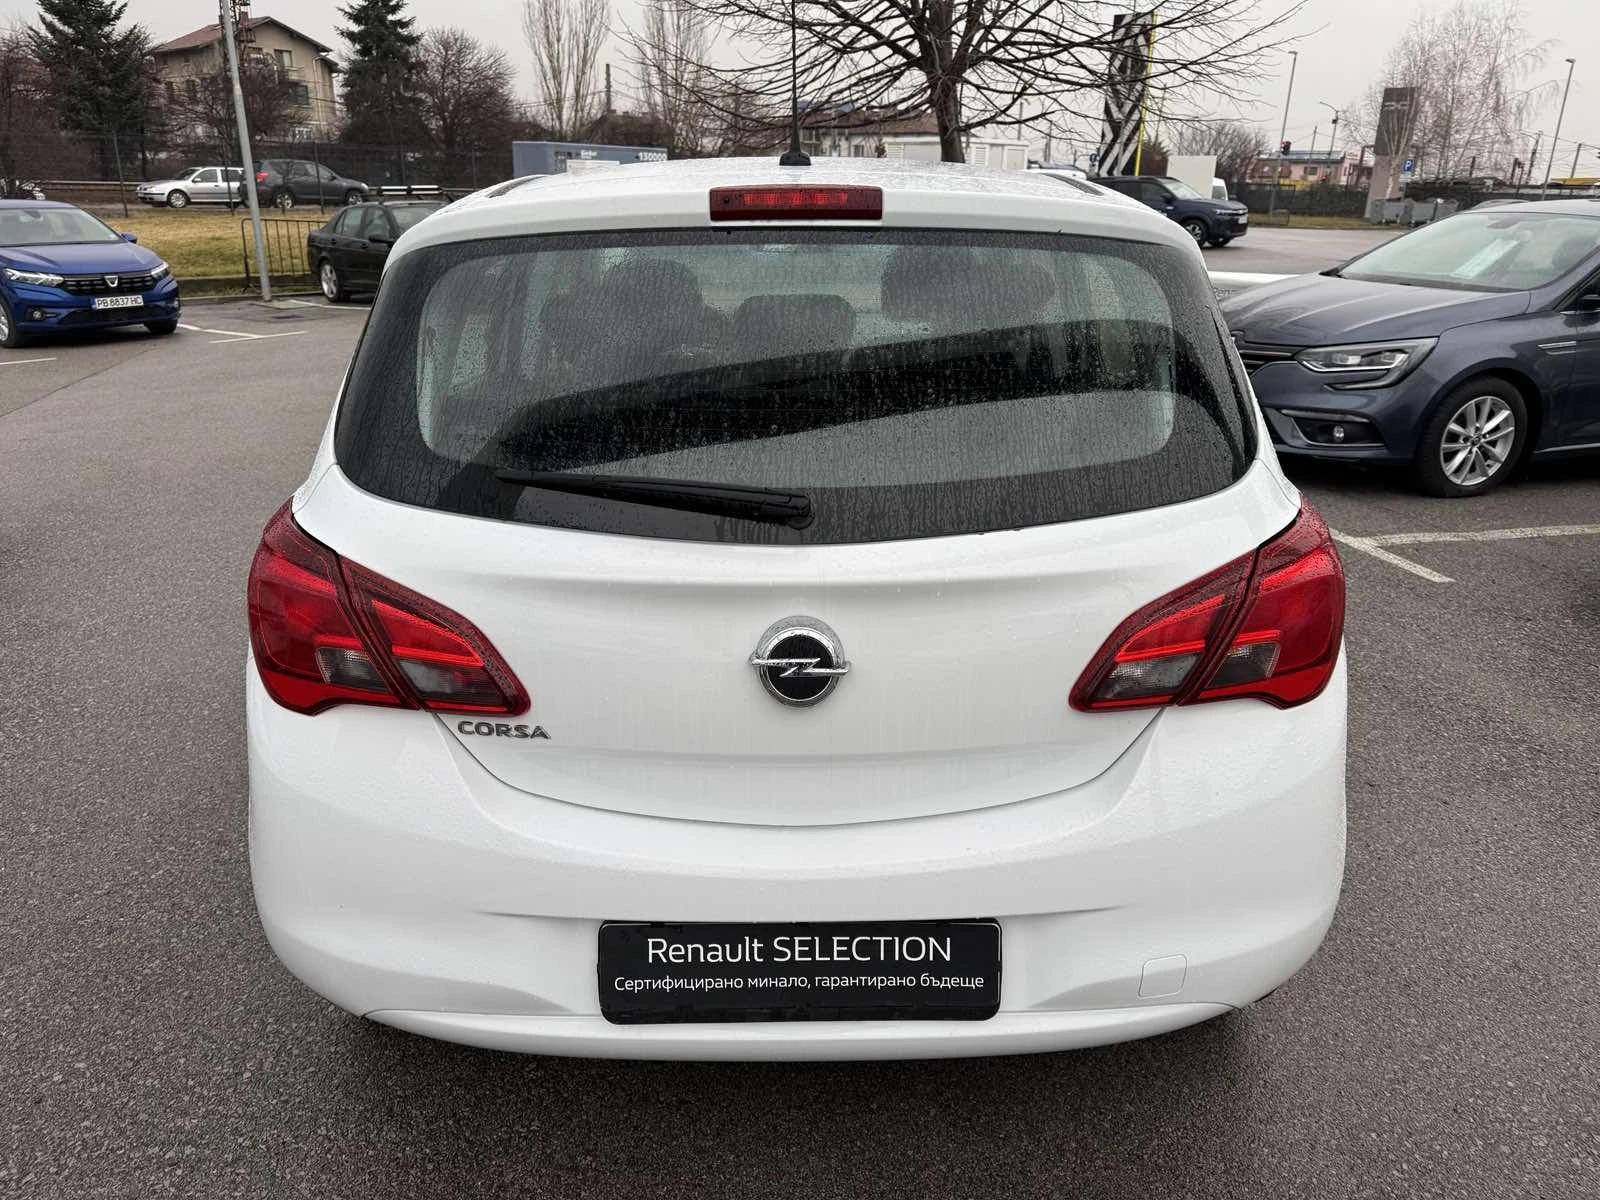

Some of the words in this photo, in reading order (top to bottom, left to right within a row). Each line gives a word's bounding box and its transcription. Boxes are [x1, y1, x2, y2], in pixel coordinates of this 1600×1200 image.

[97, 299, 109, 308] PB
[109, 297, 129, 306] 8837
[130, 296, 142, 305] HC
[457, 720, 551, 739] CORSA
[647, 936, 764, 964] Renault
[773, 936, 951, 962] SELECTION
[614, 975, 744, 994] Сертифицирано
[747, 976, 811, 990] минало,
[815, 974, 916, 991] гарантирано
[920, 973, 984, 990] бъдеще
